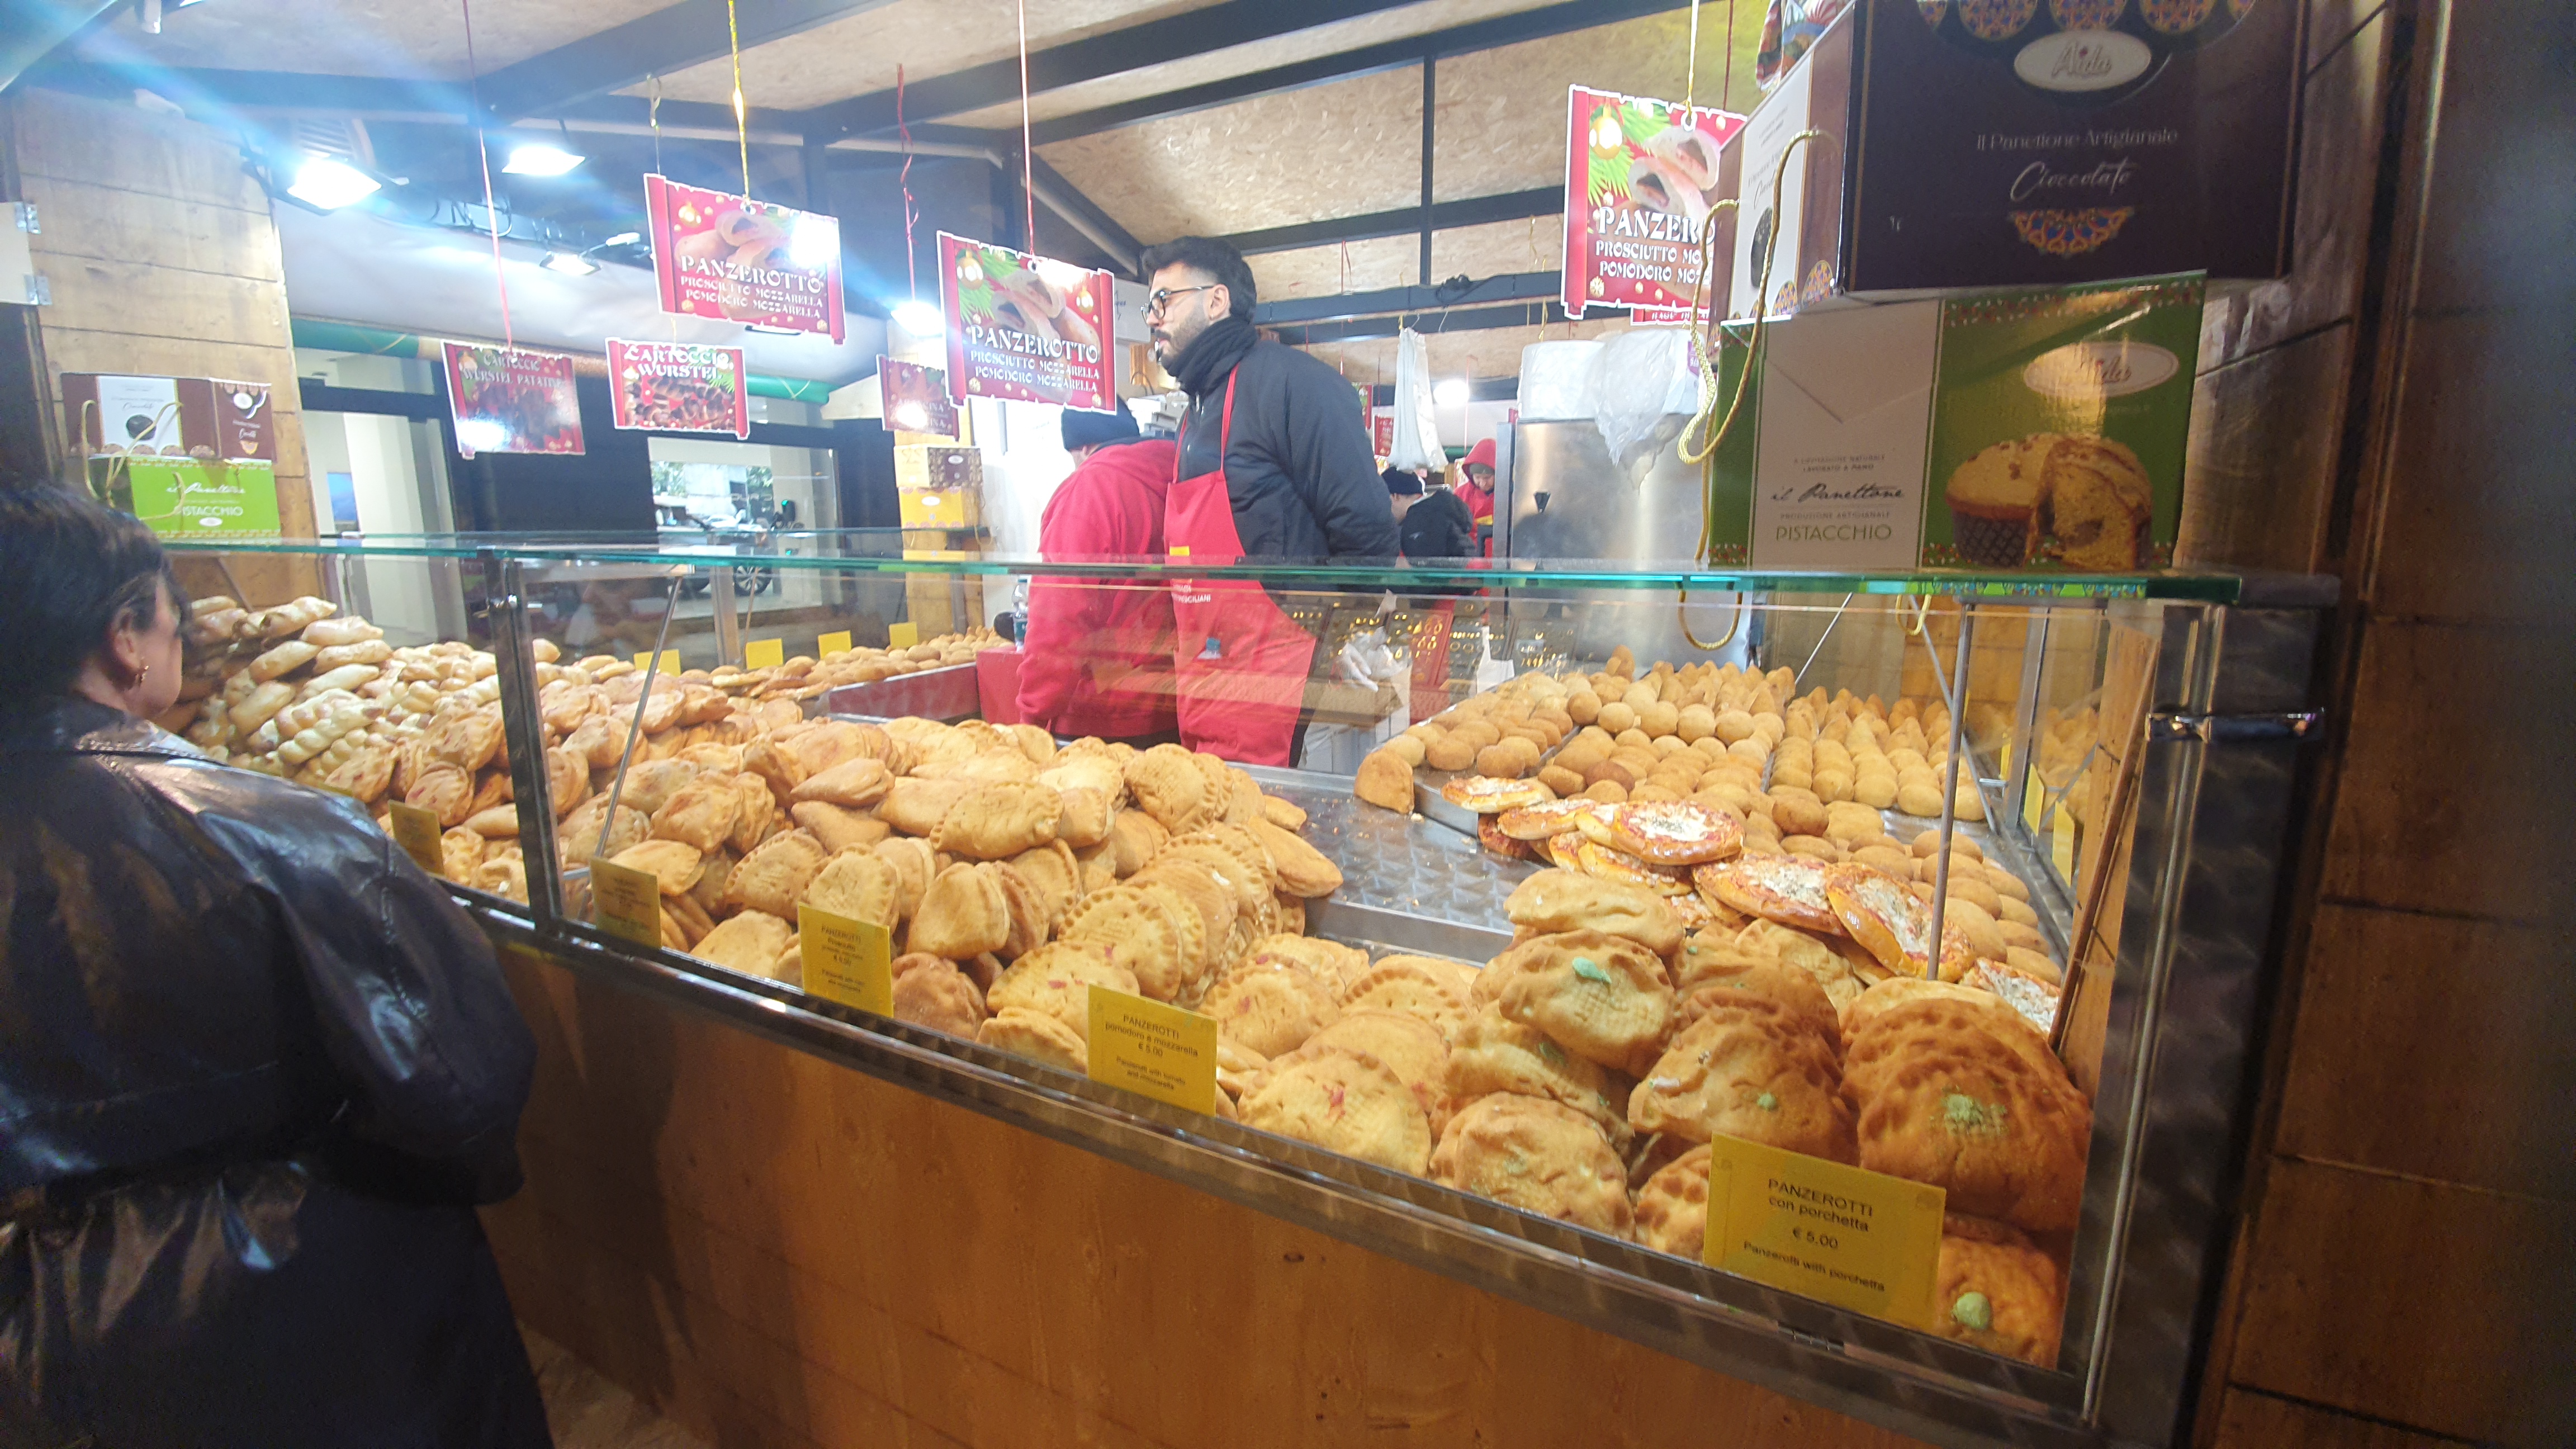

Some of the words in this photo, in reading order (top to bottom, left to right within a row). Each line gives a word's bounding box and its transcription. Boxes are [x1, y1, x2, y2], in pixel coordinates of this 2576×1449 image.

[1990, 133, 2080, 150] Panettone
[2086, 127, 2179, 149] Artigianale
[2010, 156, 2139, 202] Cioccolato
[1598, 206, 1715, 245] PANZERO
[1595, 240, 1677, 263] PROSCIUTTO
[681, 255, 821, 293] PANZEROTTO
[1599, 261, 1672, 282] POMODORO
[680, 276, 751, 296] PROSCIUTTO
[756, 287, 823, 308] MOZZARELLA
[686, 289, 749, 307] POMODORO
[753, 299, 820, 319] MOZZARELLA
[623, 345, 730, 370] CARTOCCIO
[970, 324, 1098, 364] PANZEROTTO
[463, 367, 513, 384] WURSTEL
[637, 363, 723, 380] WURSTEL
[970, 350, 1035, 370] PROSCIUTTO
[1039, 359, 1100, 380] MOZZARELLA
[975, 365, 1033, 384] POMODORO
[1037, 373, 1098, 392] MOZZARELLA
[1797, 482, 1903, 503] Panettone
[1776, 523, 1892, 542] PISTACCHIO
[1105, 1021, 1145, 1041] pomodoro
[1154, 1036, 1199, 1058] mozzarella
[1123, 1013, 1180, 1040] PANZEROTTI
[1768, 1178, 1873, 1218] PANZEROTTI
[1769, 1196, 1794, 1212] con
[1799, 1204, 1869, 1232] porchetta
[1792, 1227, 1802, 1239] €
[1744, 1240, 1800, 1267] Panzerotti
[1803, 1261, 1826, 1273] with
[1829, 1268, 1885, 1292] porchetta
